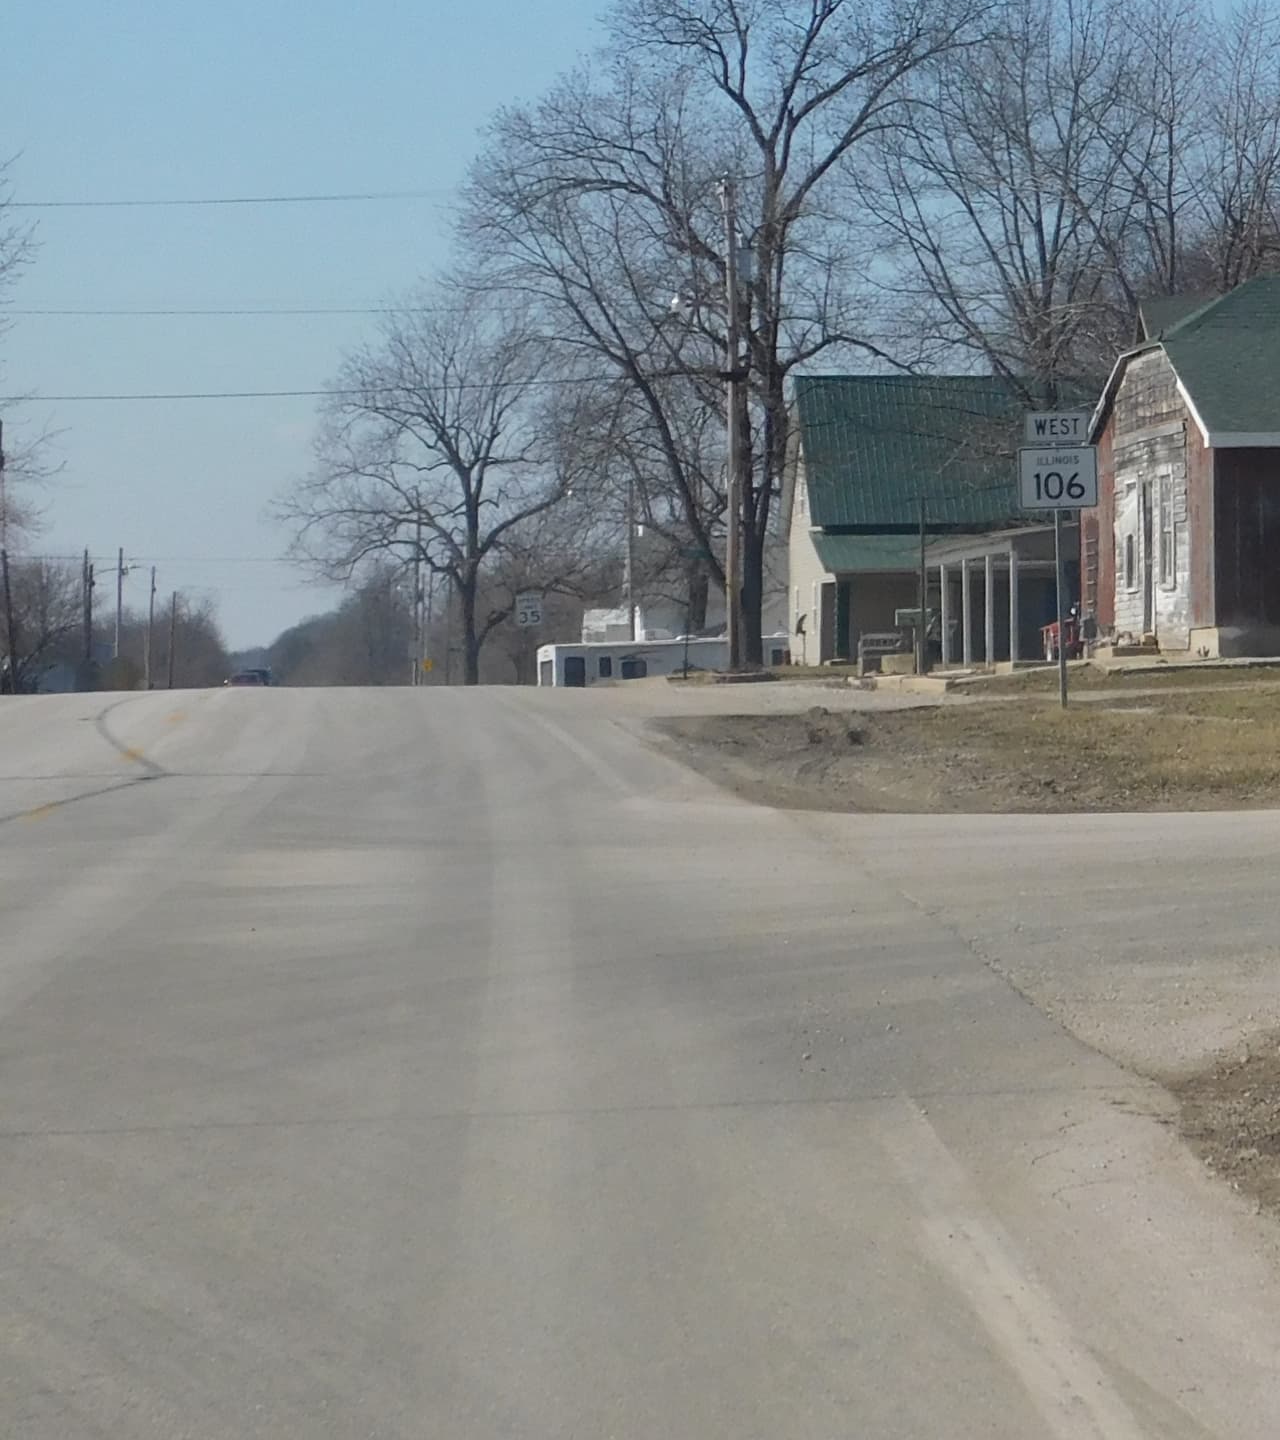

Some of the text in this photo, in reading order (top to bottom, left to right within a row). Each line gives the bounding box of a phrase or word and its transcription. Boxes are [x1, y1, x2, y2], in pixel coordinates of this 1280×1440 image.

[1034, 418, 1080, 435] WEST
[1036, 455, 1080, 466] ILLINOIS
[1033, 472, 1085, 500] 106
[519, 610, 540, 624] 35
